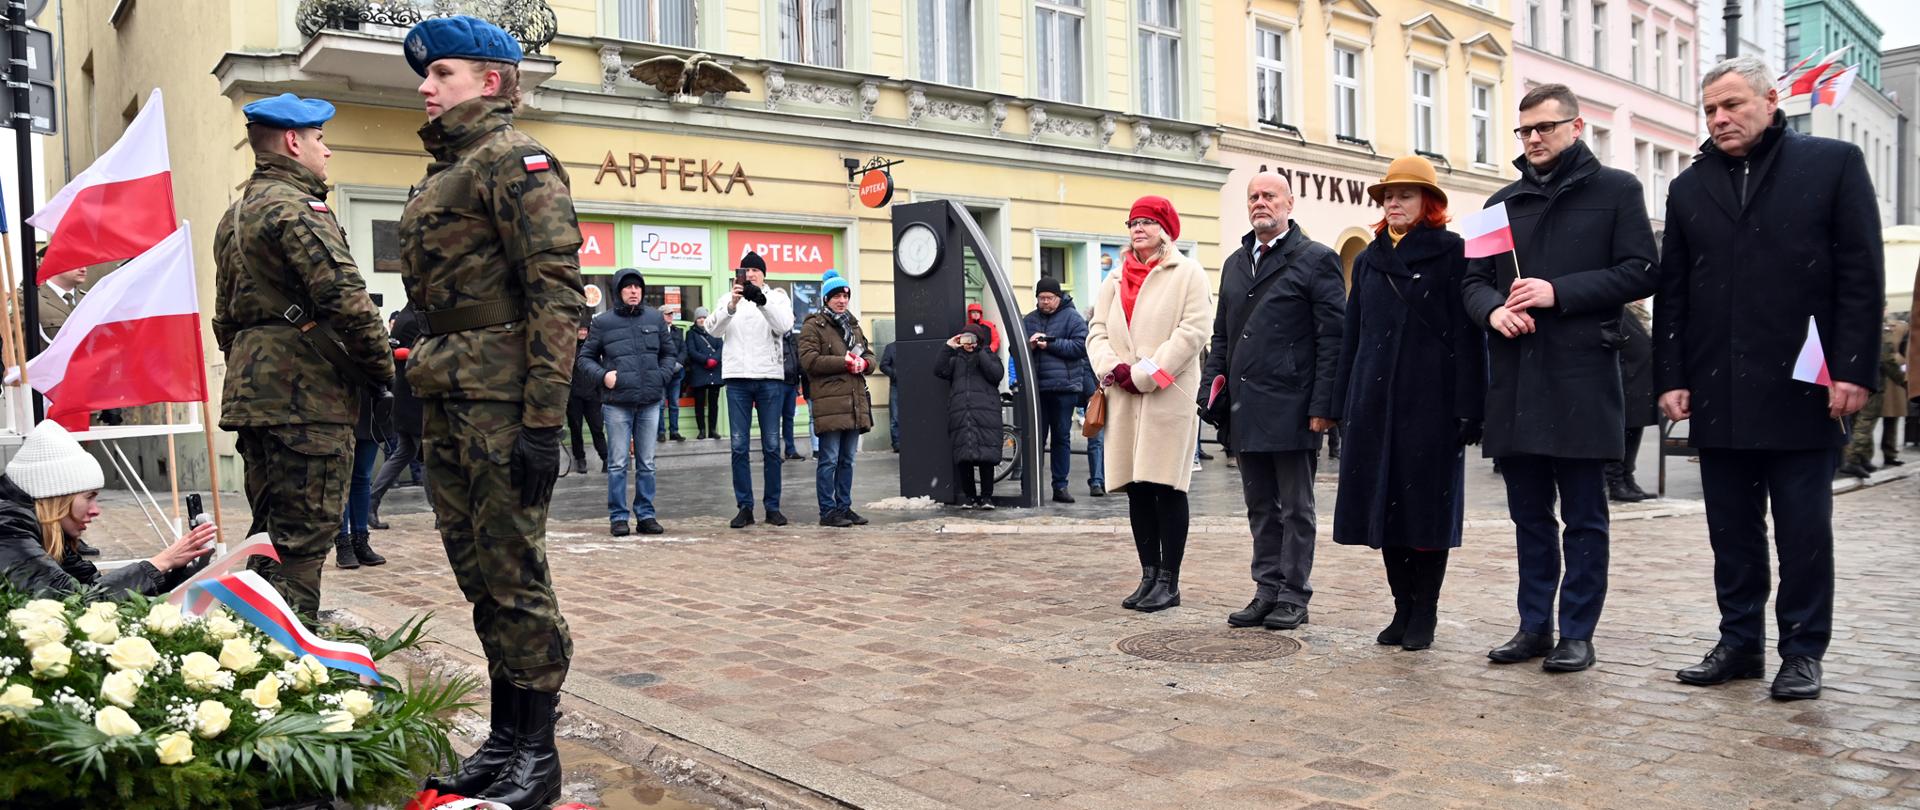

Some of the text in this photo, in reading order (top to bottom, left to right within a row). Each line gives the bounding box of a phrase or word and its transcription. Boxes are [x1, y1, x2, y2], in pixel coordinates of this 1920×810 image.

[594, 150, 754, 196] APTEKA
[861, 182, 886, 196] APTEKA
[577, 235, 601, 255] A
[670, 242, 702, 255] DOZ
